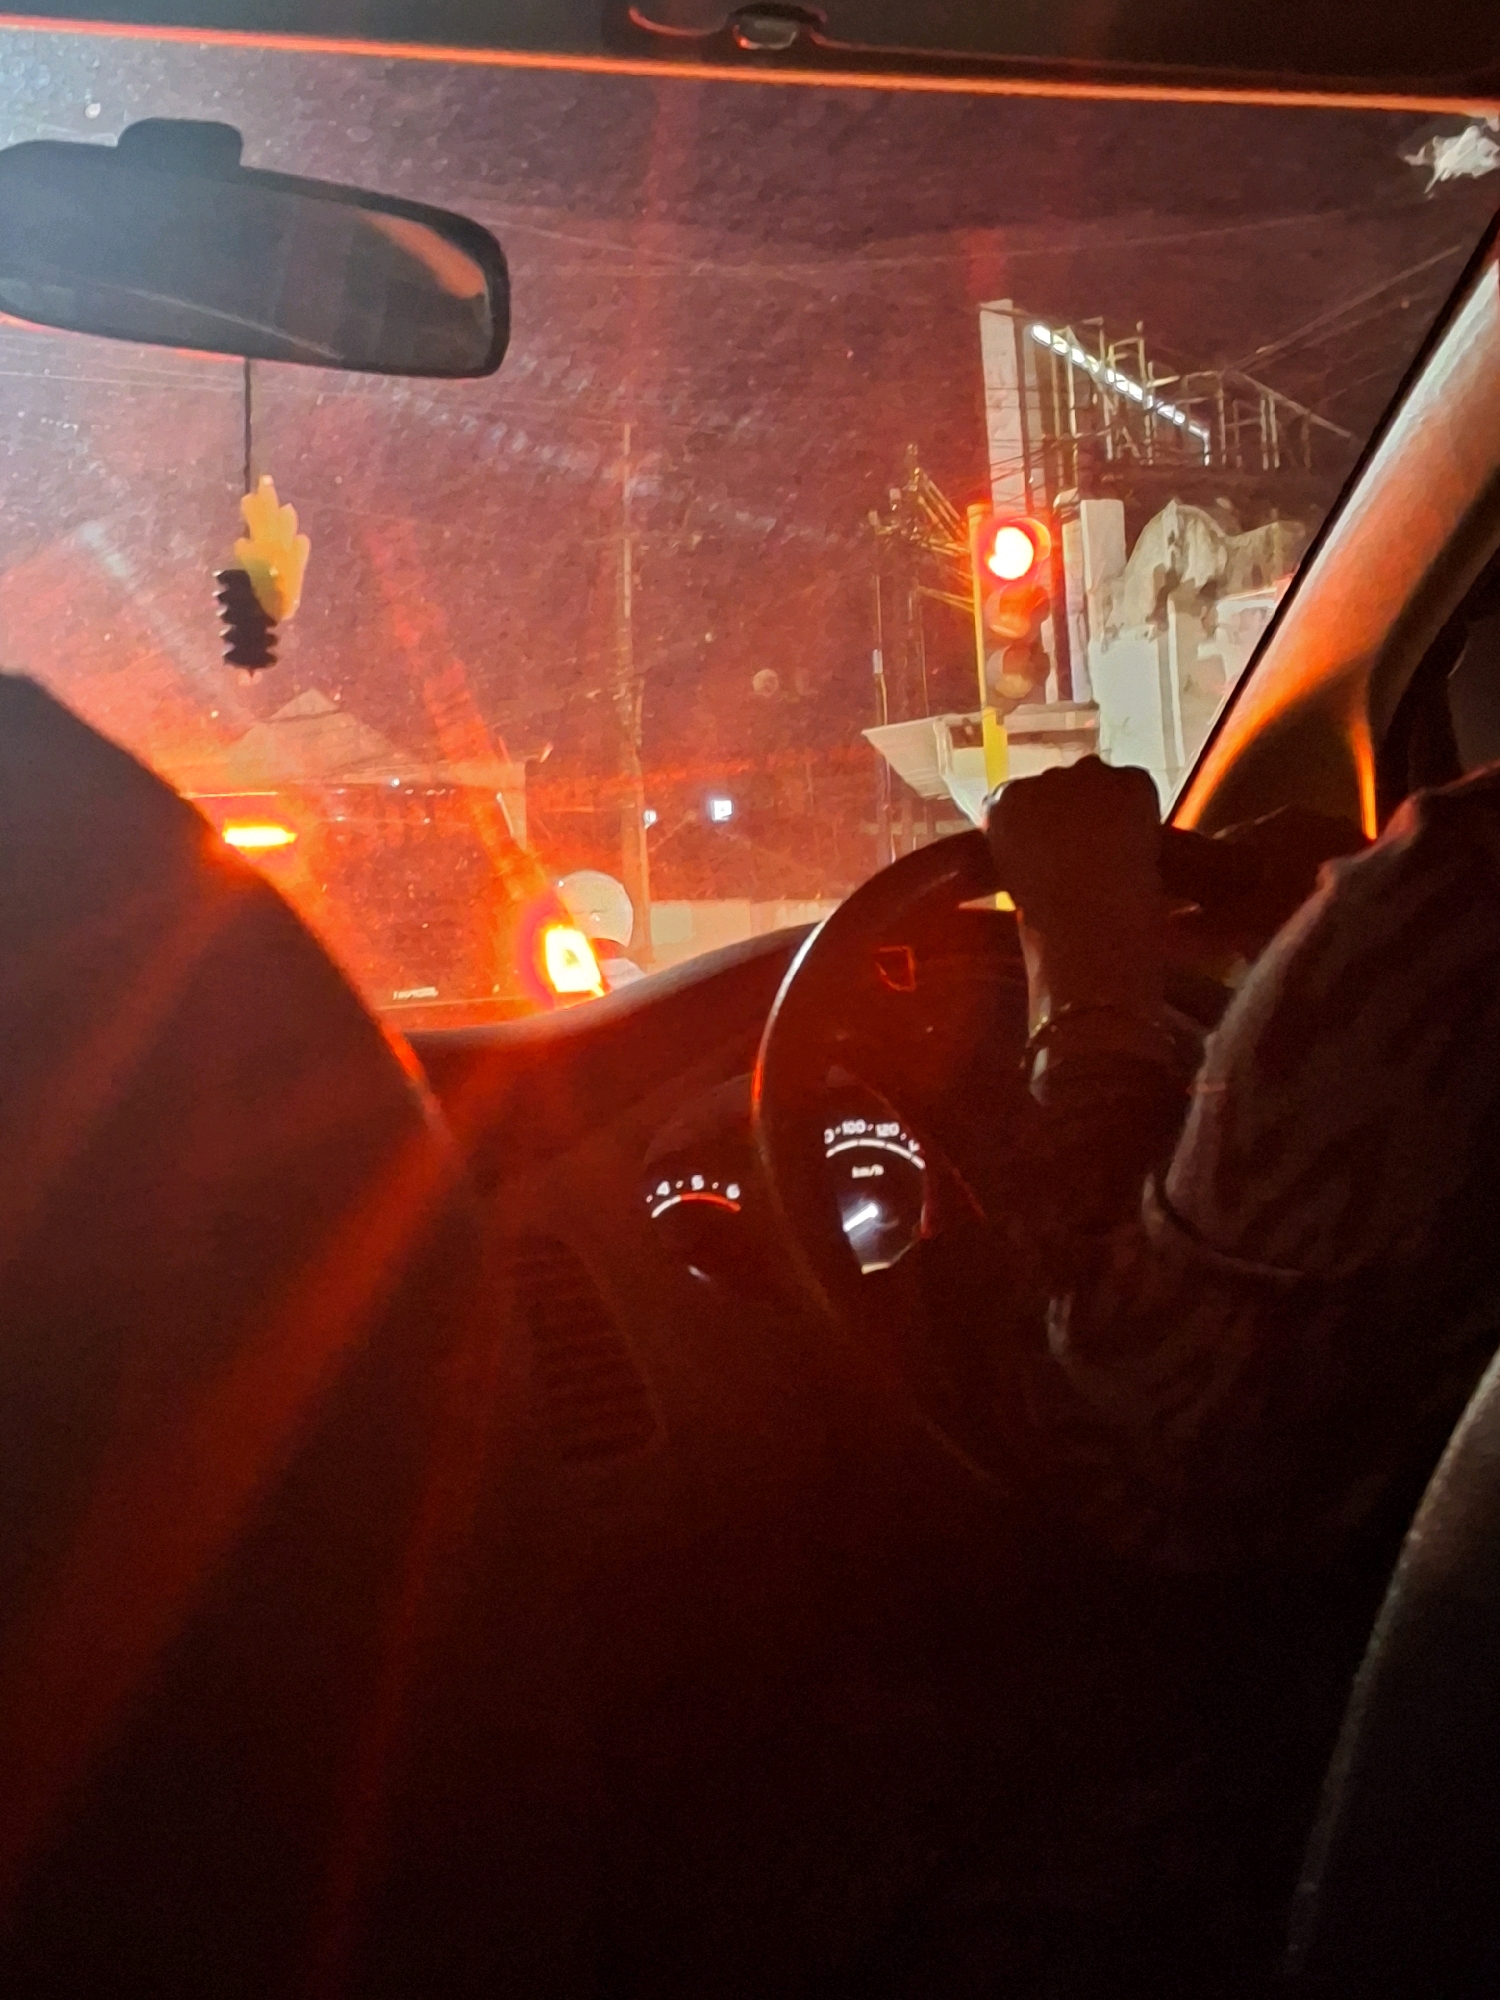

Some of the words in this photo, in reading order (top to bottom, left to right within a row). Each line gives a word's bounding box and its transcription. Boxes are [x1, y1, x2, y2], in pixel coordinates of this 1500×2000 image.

[842, 1118, 867, 1136] 100
[875, 1122, 900, 1138] 120
[656, 1180, 671, 1197] 4
[726, 1183, 741, 1200] 6
